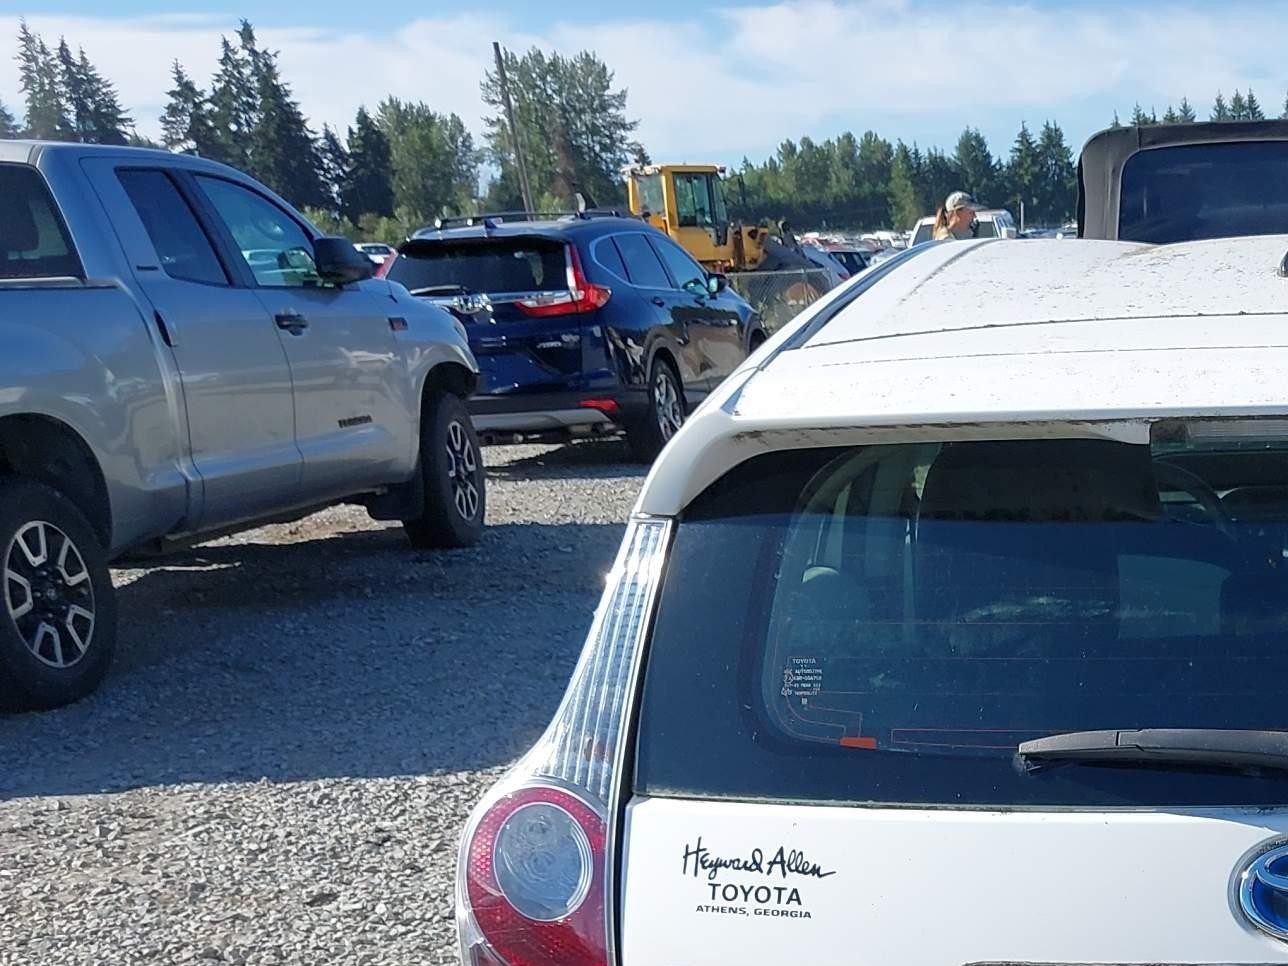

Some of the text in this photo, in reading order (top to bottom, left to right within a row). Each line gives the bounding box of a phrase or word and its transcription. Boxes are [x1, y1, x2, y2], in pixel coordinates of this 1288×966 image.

[682, 836, 836, 880] Heyward Allen
[708, 883, 802, 906] TOYOTA
[696, 904, 812, 919] ATHENS, GEORGIA
